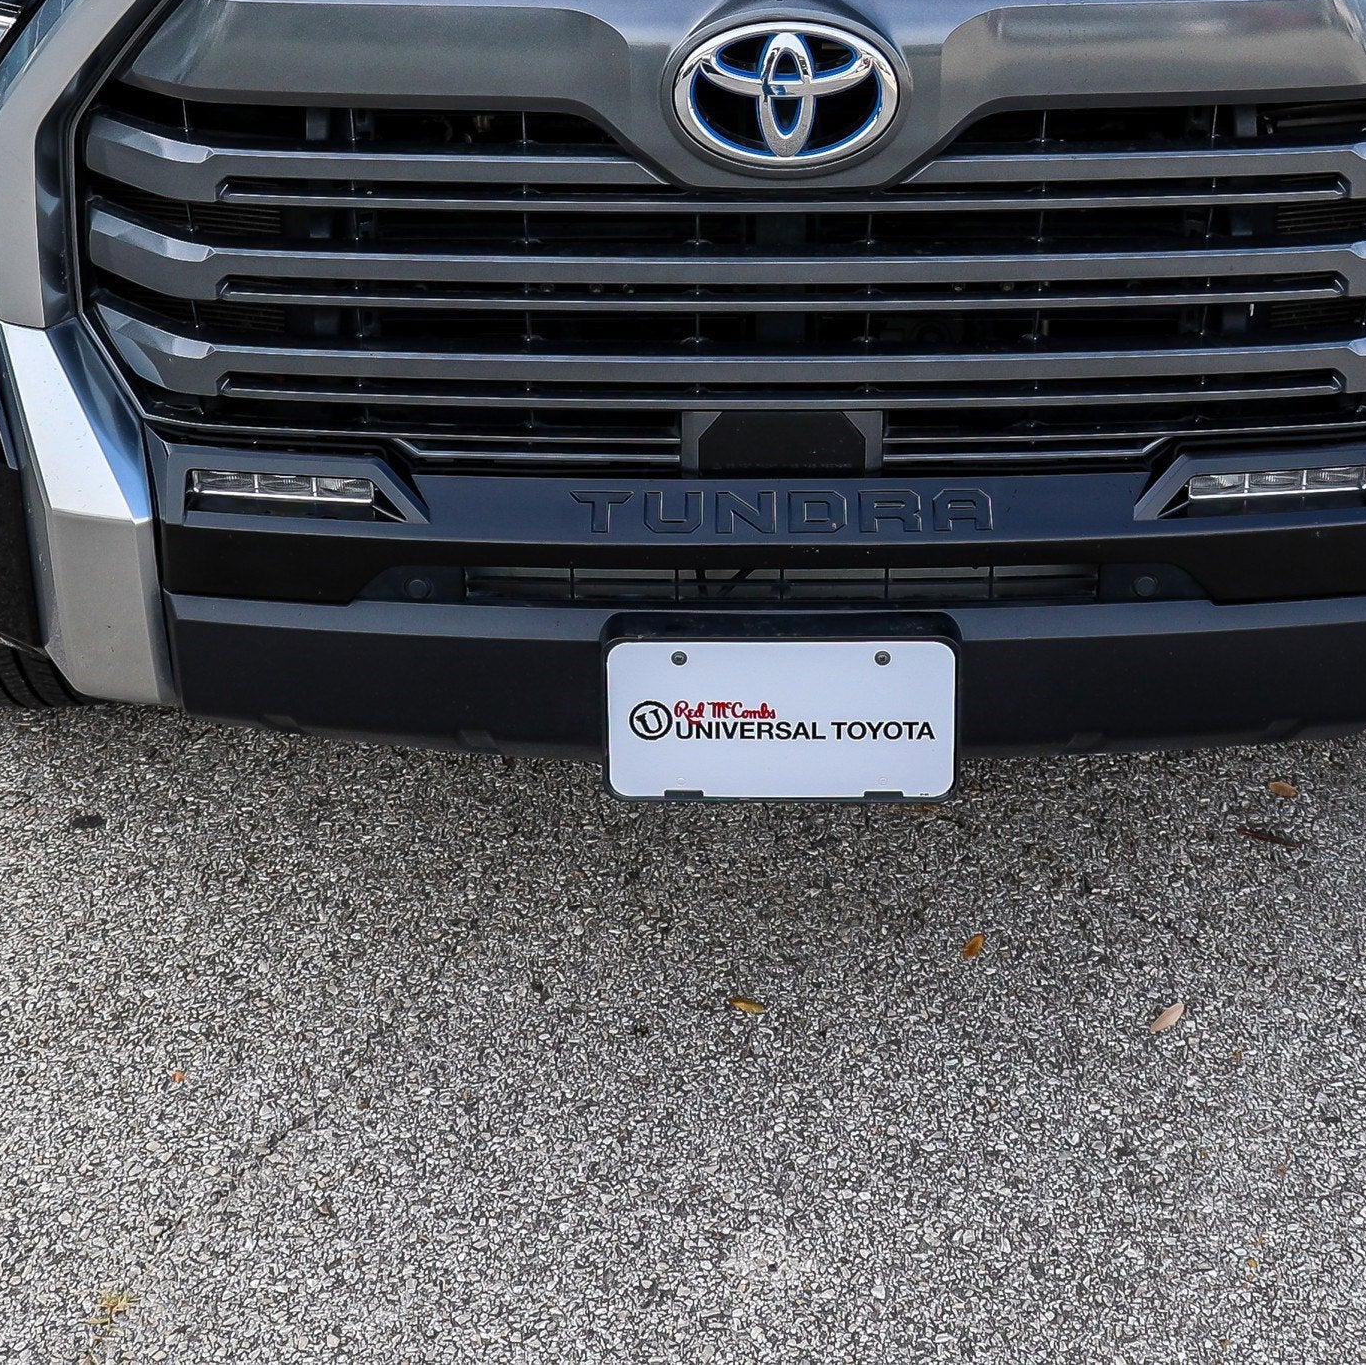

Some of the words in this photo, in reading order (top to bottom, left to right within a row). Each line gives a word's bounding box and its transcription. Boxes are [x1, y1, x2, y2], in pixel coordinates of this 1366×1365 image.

[569, 488, 994, 534] TUNDRA
[674, 700, 705, 725] Red
[707, 701, 777, 720] McCombs
[675, 721, 827, 740] UNIVERSAL
[831, 721, 935, 740] TOYOTA
